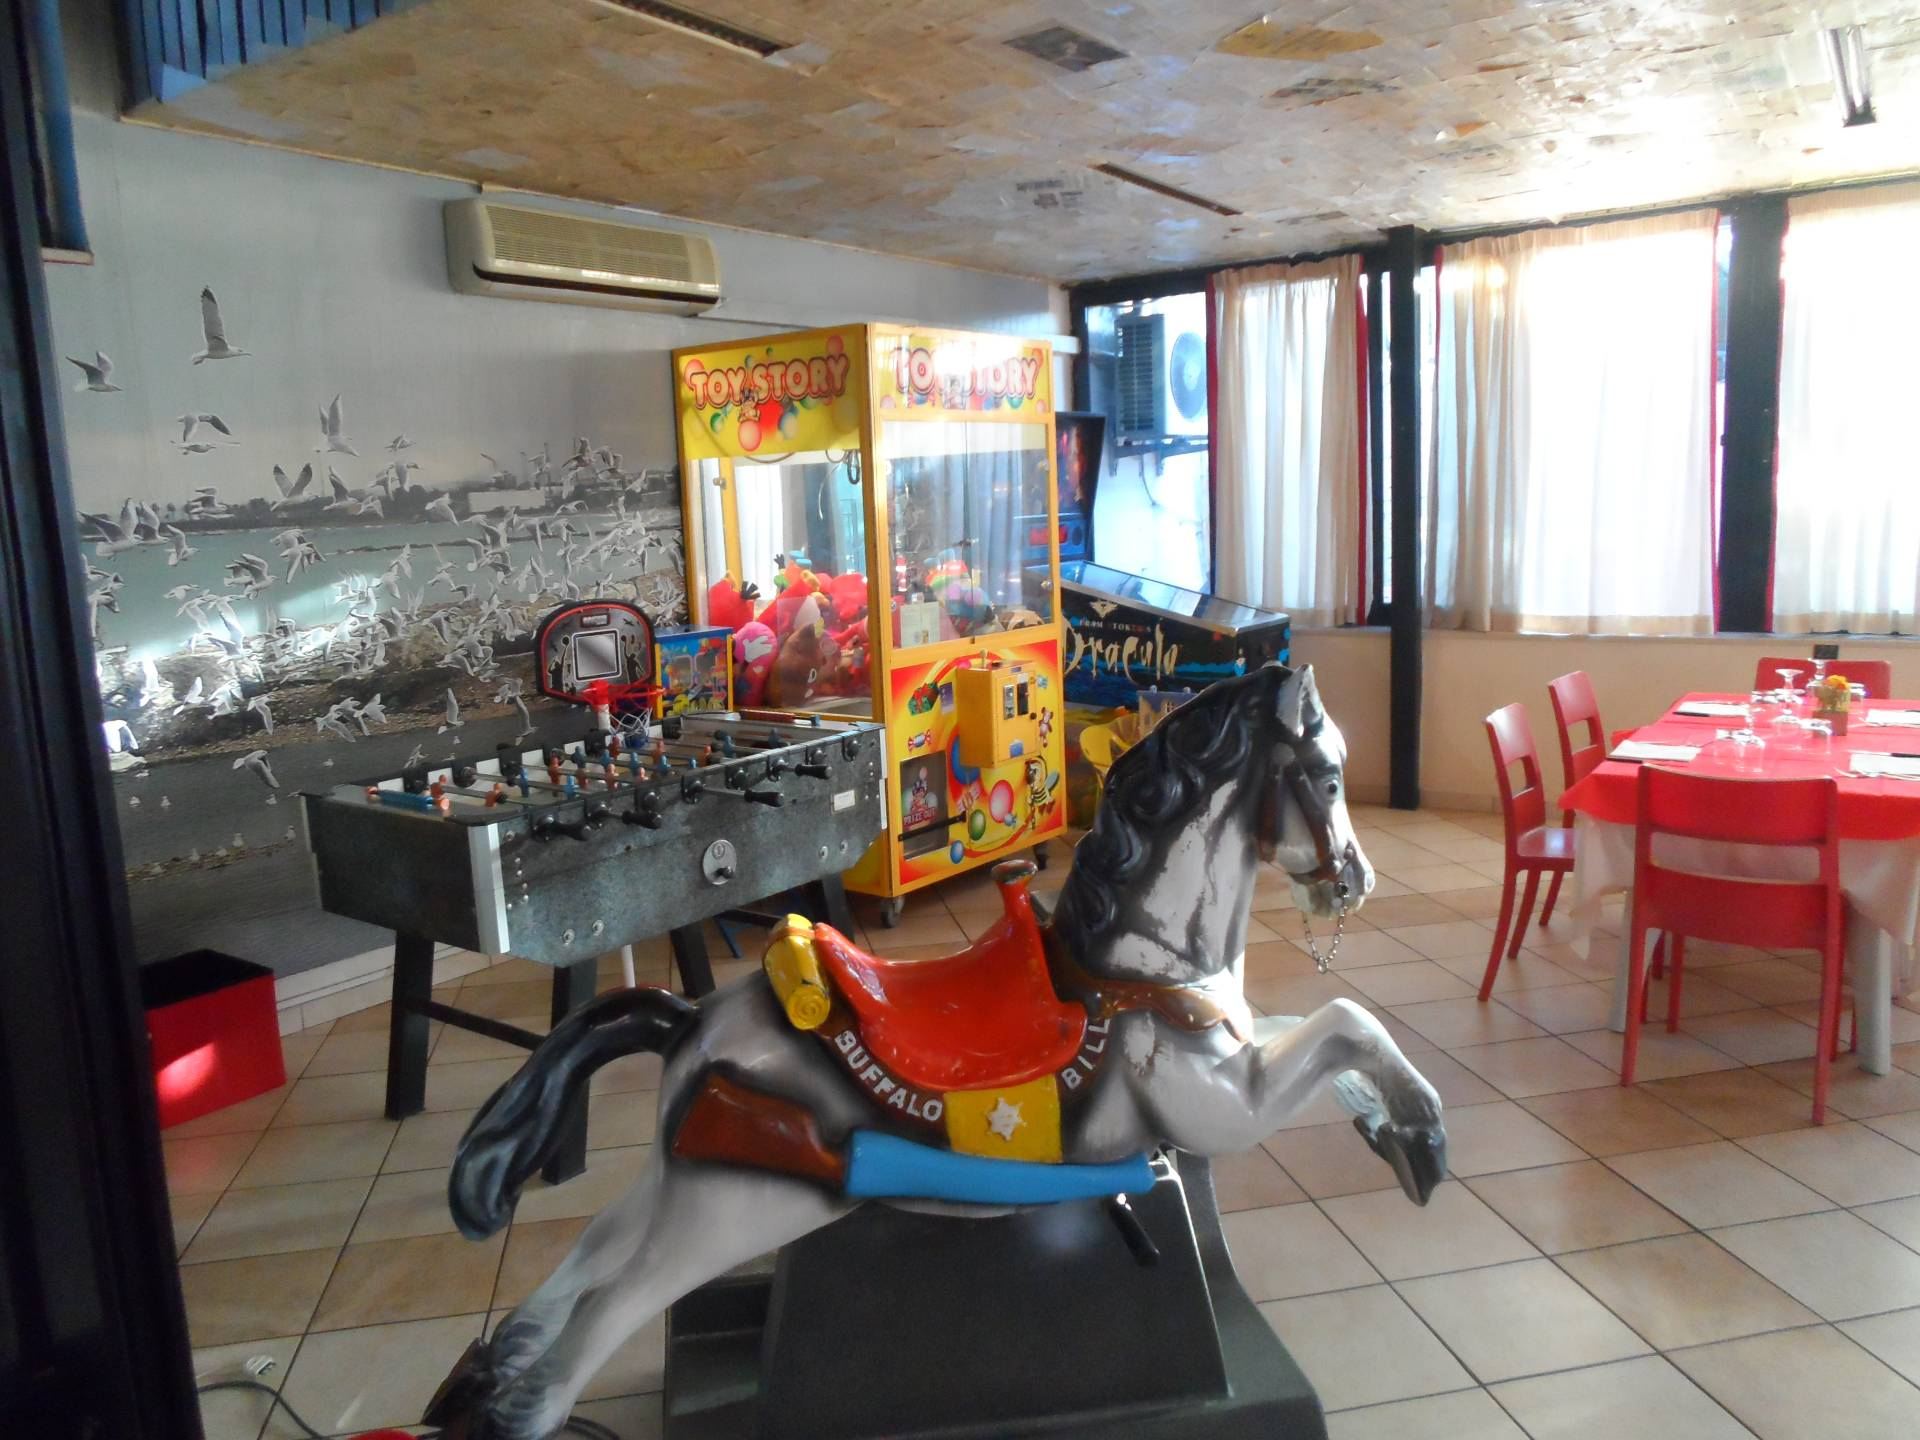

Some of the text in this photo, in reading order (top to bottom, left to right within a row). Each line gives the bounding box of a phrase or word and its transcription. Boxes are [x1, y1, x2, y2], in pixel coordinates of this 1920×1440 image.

[690, 353, 849, 410] TOY STORY
[834, 1017, 1111, 1122] BUFFALO BILL
